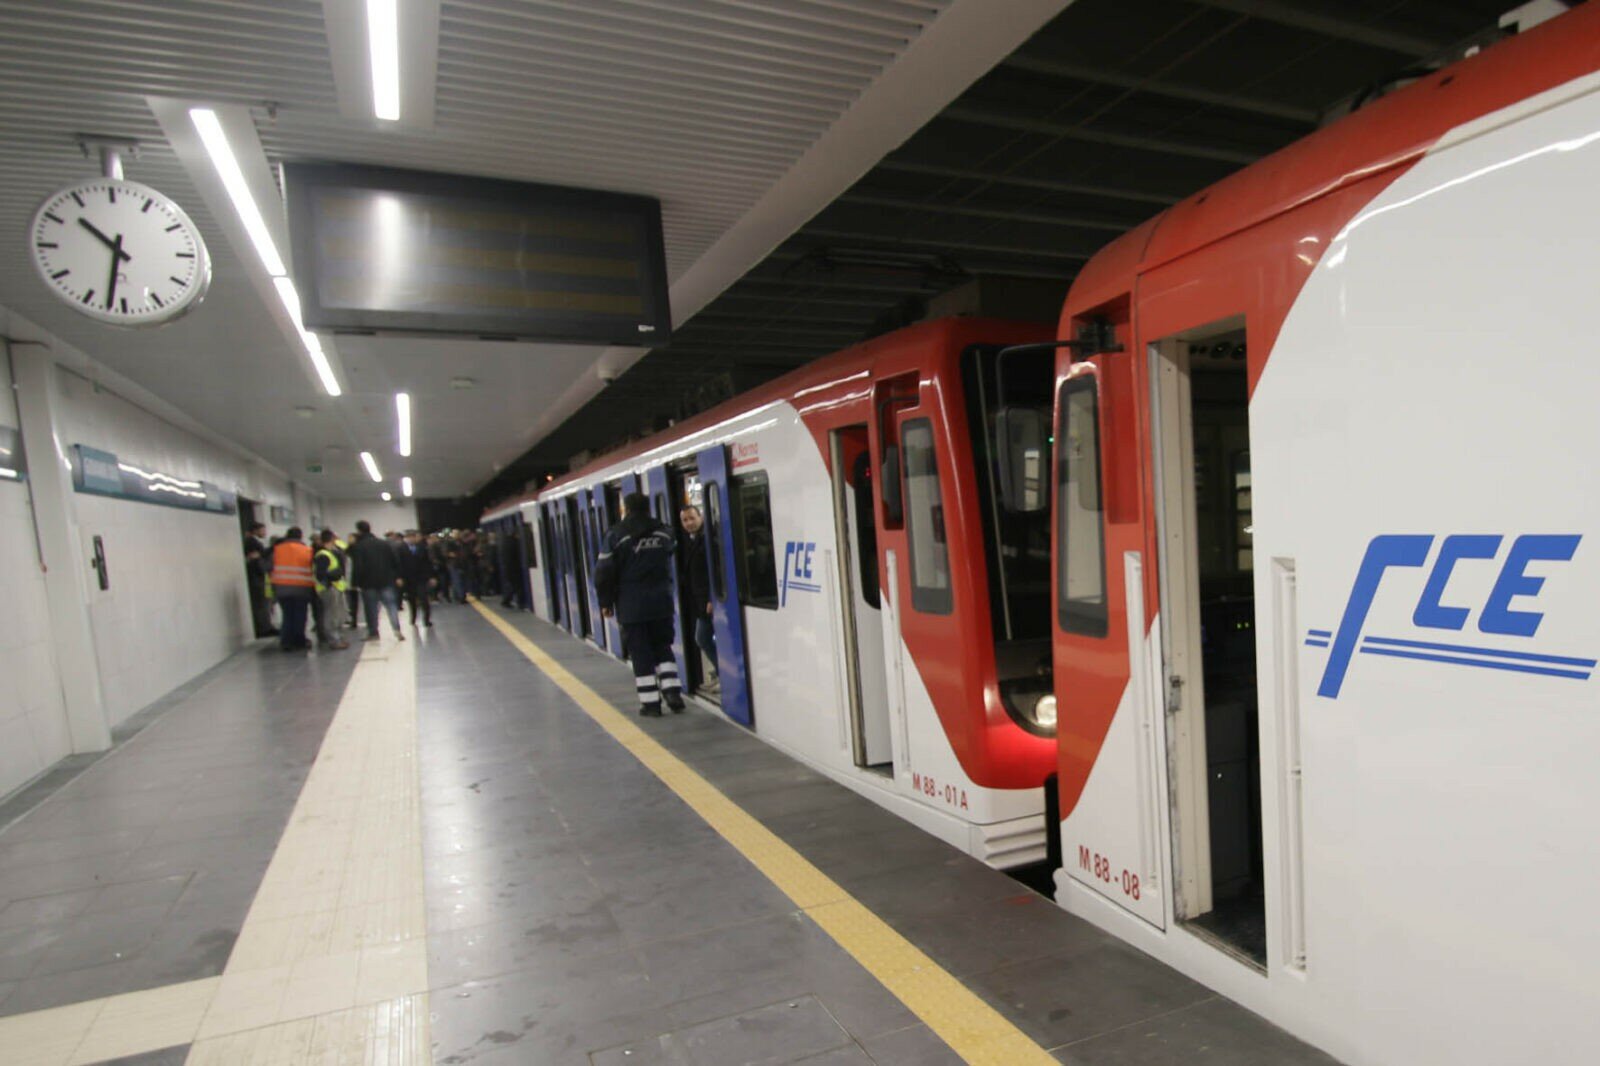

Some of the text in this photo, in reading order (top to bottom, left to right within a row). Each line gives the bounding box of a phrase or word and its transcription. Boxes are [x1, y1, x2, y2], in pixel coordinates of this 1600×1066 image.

[781, 542, 817, 608] FCE
[1316, 534, 1584, 700] FCE
[912, 771, 921, 790] M
[923, 776, 935, 797] 88
[1079, 844, 1091, 873] M
[1094, 853, 1110, 884] 88
